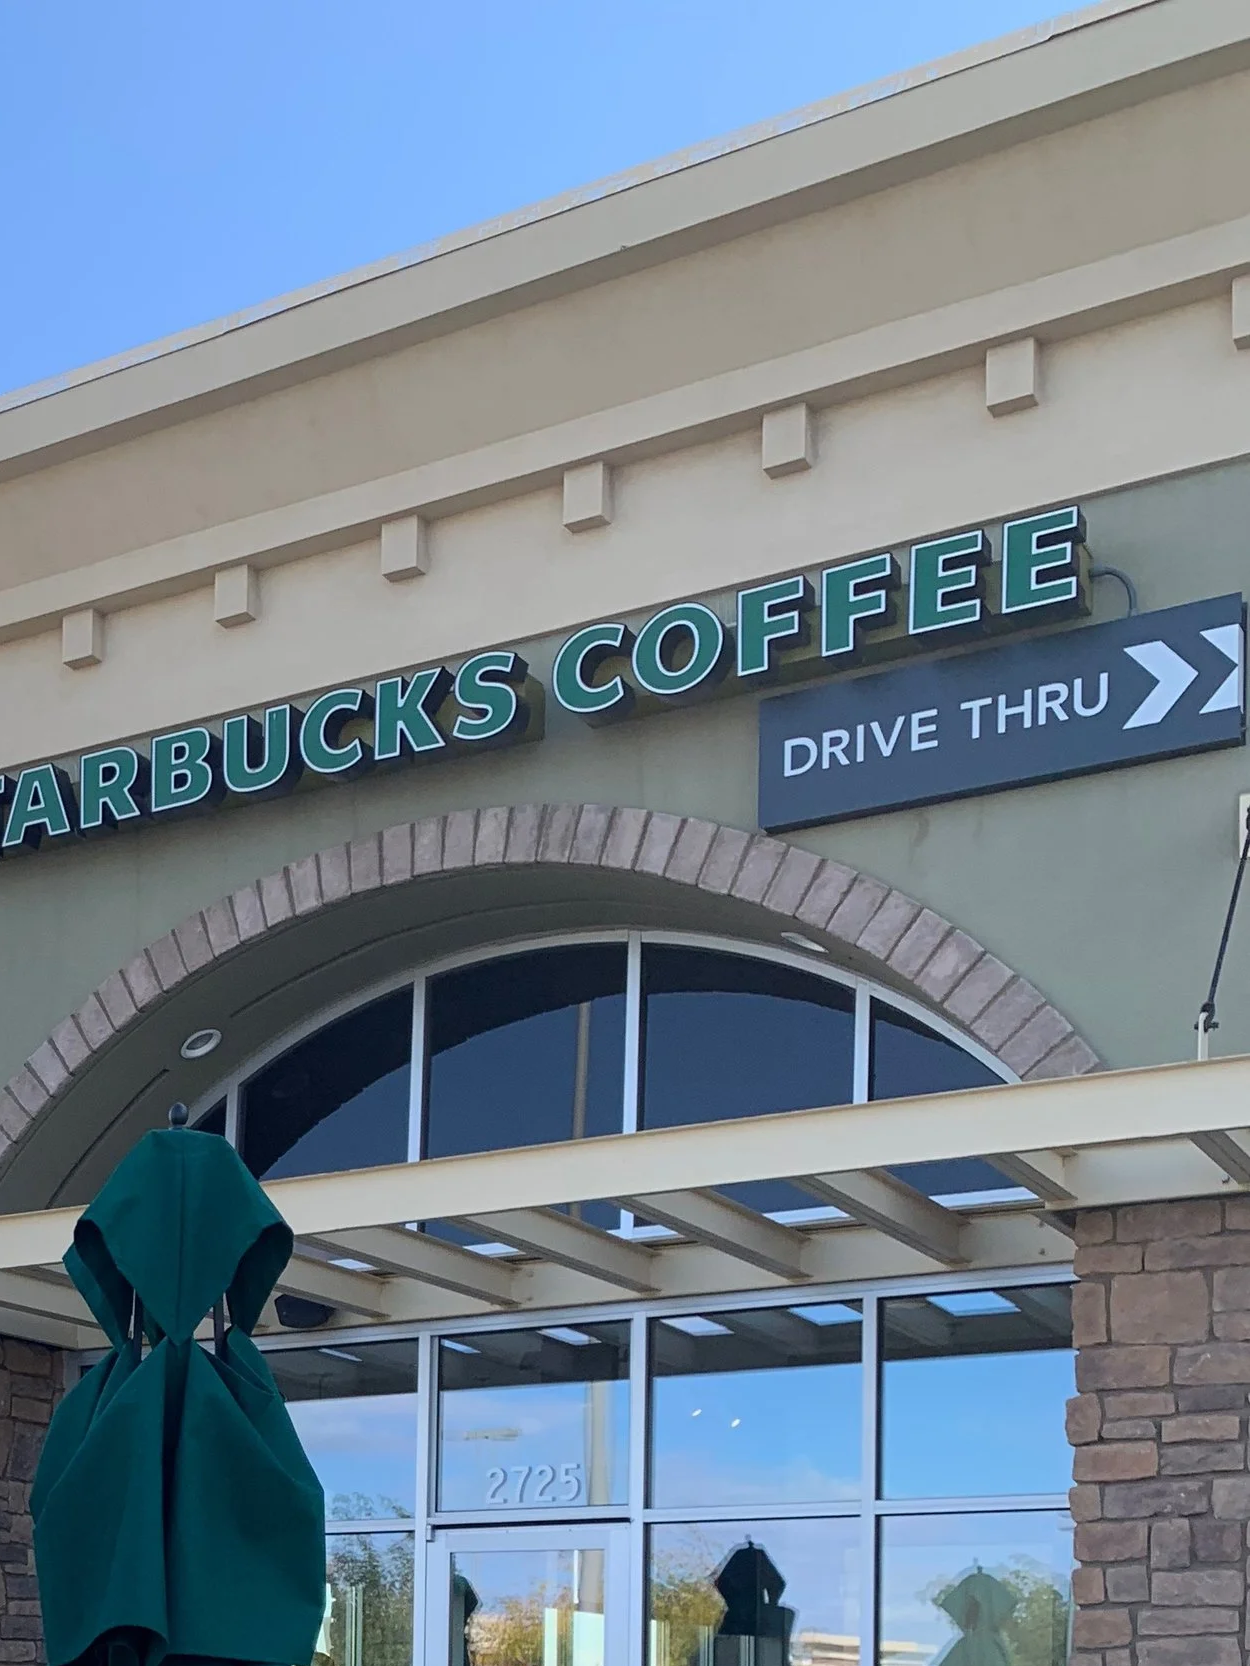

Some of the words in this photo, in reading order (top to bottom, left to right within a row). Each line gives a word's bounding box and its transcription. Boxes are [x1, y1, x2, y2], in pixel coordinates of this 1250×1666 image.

[551, 504, 1084, 716] COFFEE
[782, 706, 939, 779] DRIVE
[959, 671, 1111, 741] THRU
[486, 1464, 582, 1505] 2725
